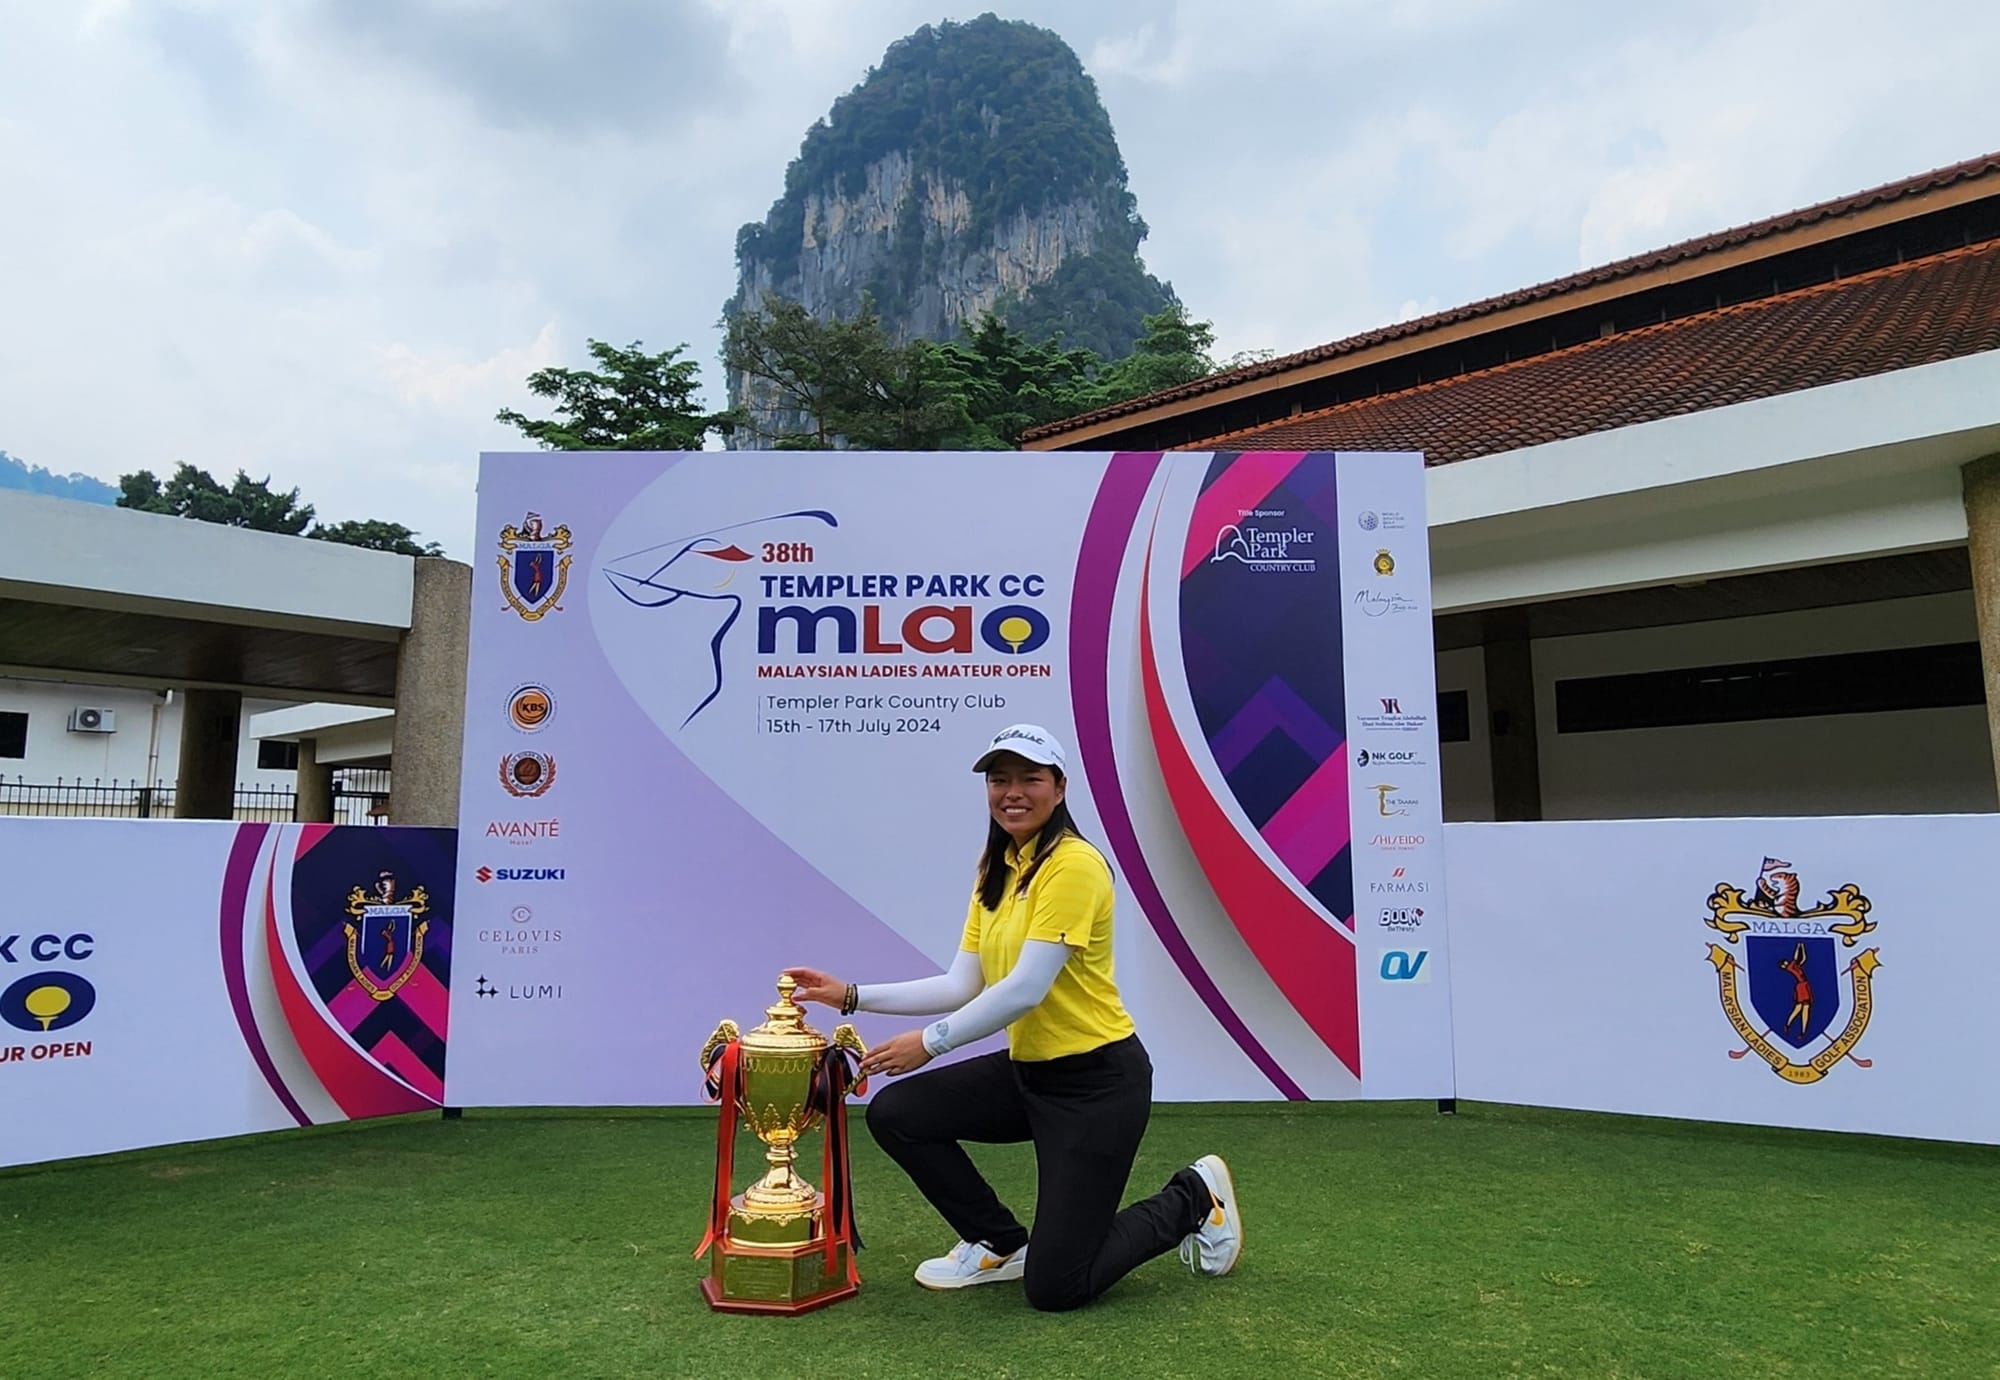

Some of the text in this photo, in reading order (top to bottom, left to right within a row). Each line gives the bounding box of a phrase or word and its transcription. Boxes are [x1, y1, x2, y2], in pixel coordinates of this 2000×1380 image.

[1238, 509, 1285, 518] Title Sponsor
[1246, 527, 1315, 548] Templer
[761, 542, 814, 563] 38th
[1250, 543, 1289, 558] Park
[1250, 564, 1316, 572] COUNTRY CLUB
[760, 574, 1045, 598] TEMPLER PARK CC
[757, 664, 1051, 678] MALAYSIAN LADIES AMATEUR OPEN
[522, 702, 545, 714] KBS
[767, 694, 1006, 713] Templer Park Country Club
[767, 719, 800, 733] 15th
[818, 719, 851, 733] 17th
[856, 719, 891, 736] July
[896, 718, 941, 733] 2024
[1372, 752, 1414, 760] NK GOLF
[486, 818, 560, 837] AVANTÉ
[1368, 834, 1425, 845] SHISEIDO
[496, 868, 565, 880] SUZUKI
[1370, 882, 1429, 892] FARMASI
[369, 907, 408, 915] MALGA
[1751, 920, 1828, 936] MALGA
[479, 930, 562, 942] CELOVIS
[31, 933, 94, 962] CC
[502, 946, 538, 954] PARIS
[510, 985, 562, 999] LUMI
[1722, 970, 1783, 1066] MALAYSIAN LADIES
[1815, 975, 1869, 1069] GOLF ASSOCIATION
[31, 1041, 92, 1060] OPEN
